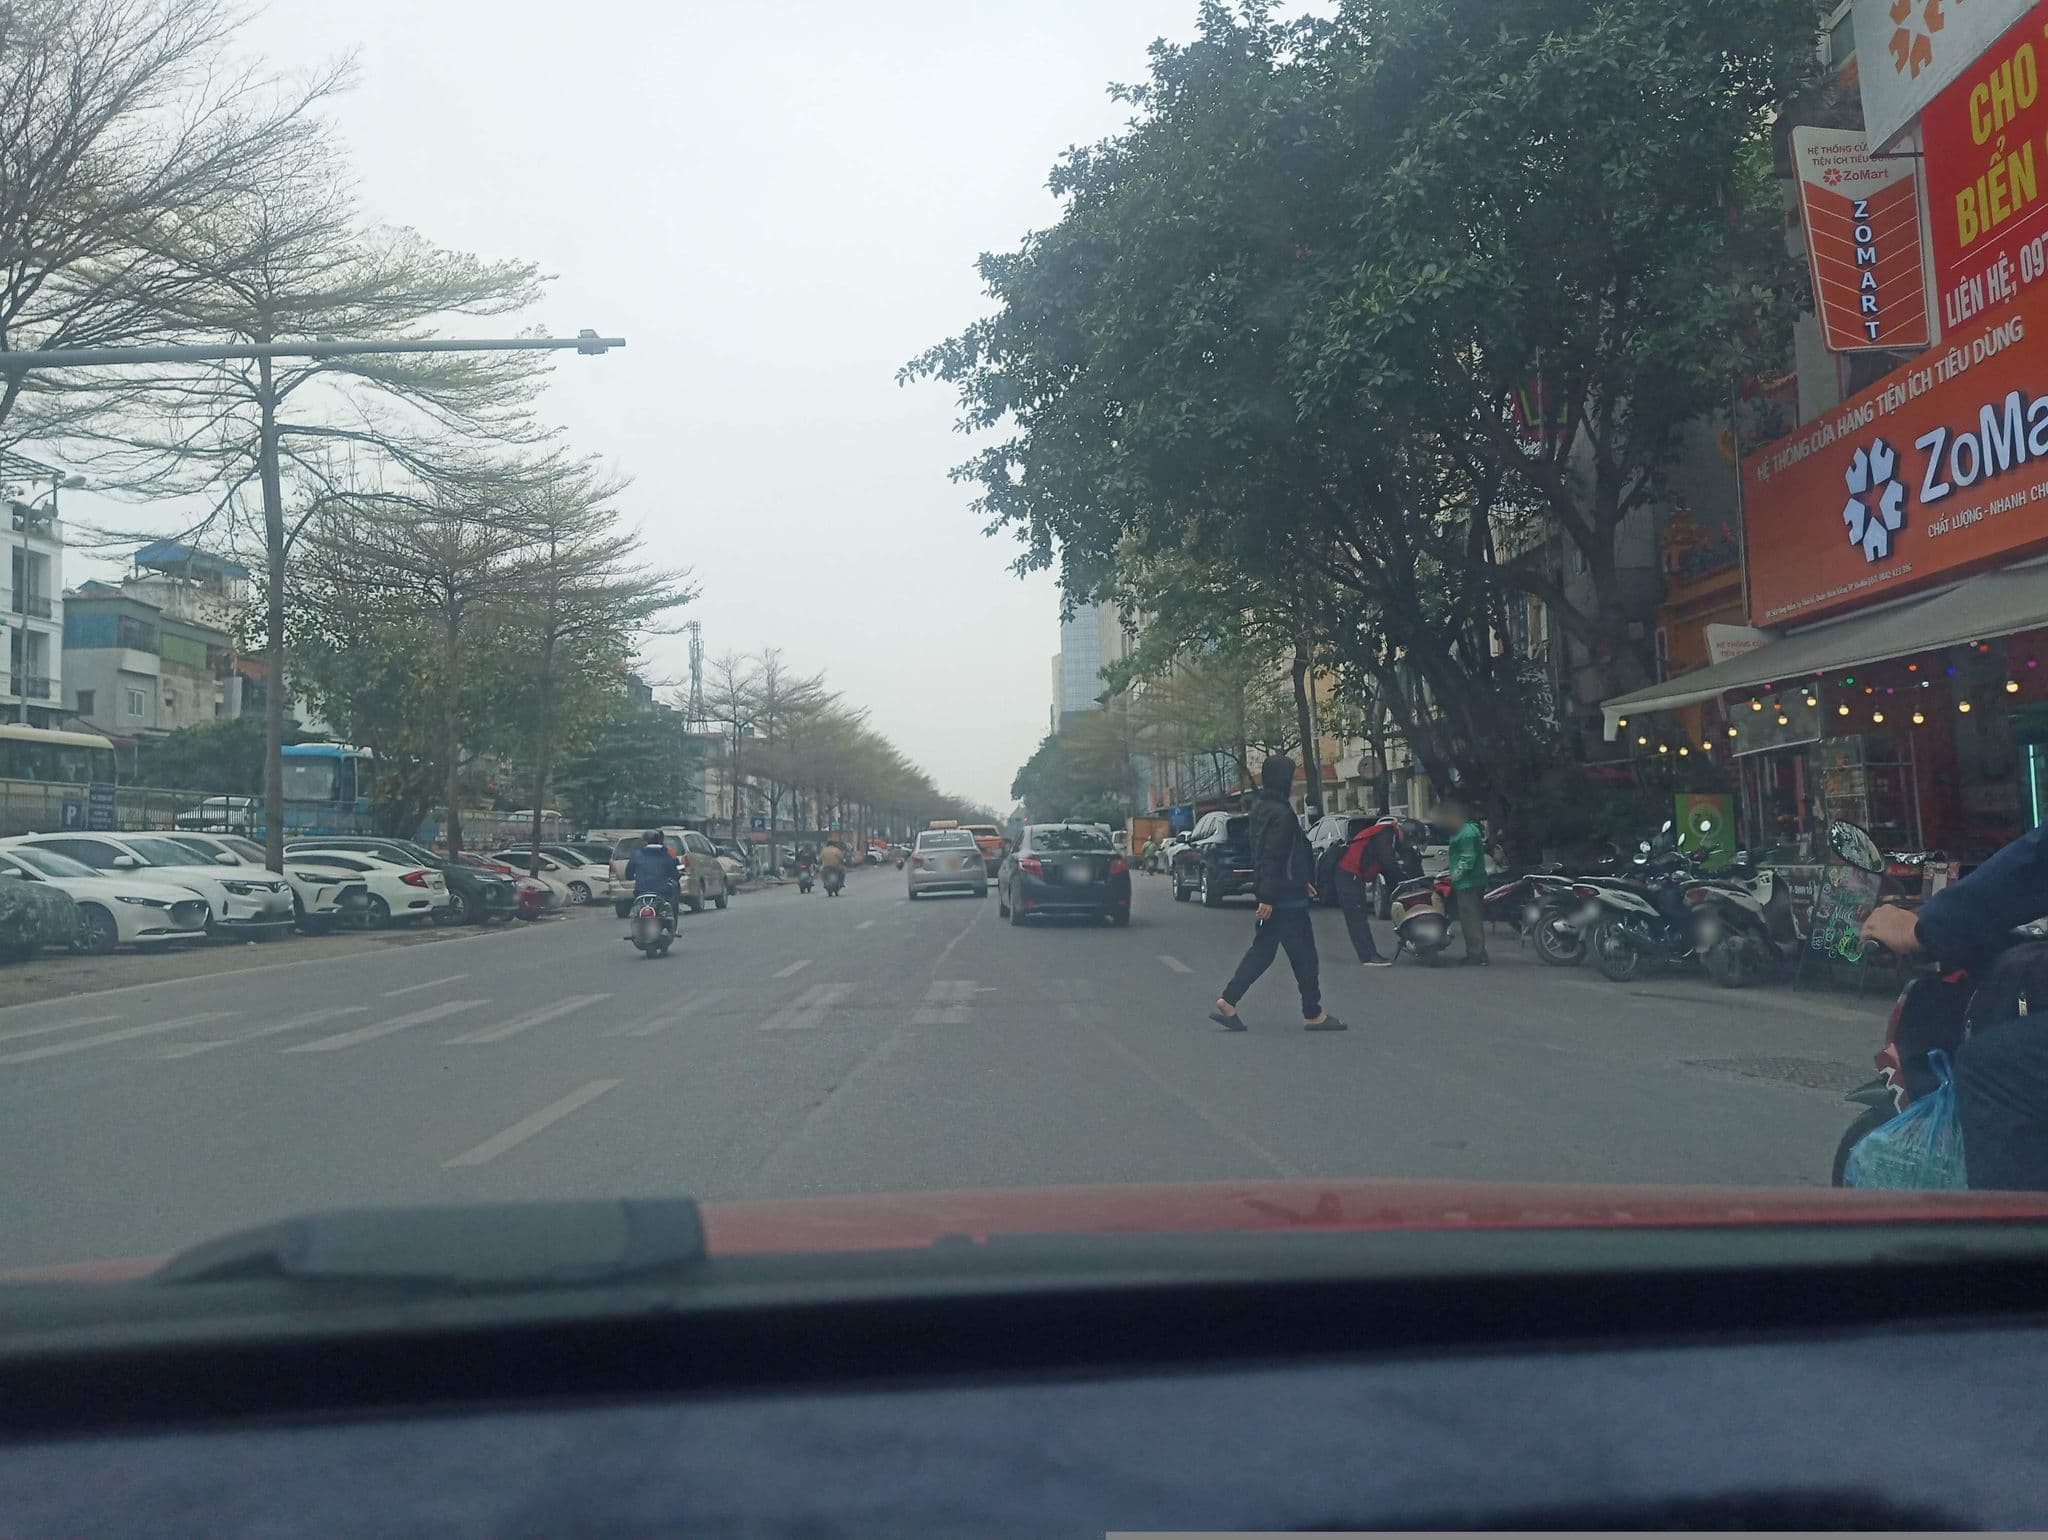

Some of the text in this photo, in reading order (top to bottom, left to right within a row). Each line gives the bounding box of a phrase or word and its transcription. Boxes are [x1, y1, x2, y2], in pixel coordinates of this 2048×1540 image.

[1969, 43, 2038, 146] CHO
[1843, 168, 1889, 181] ZoMart
[1854, 142, 1869, 153] CỬ
[1956, 135, 2038, 248] BIỂN
[1854, 200, 1880, 339] ZOMART
[1945, 273, 1984, 329] LIÊN
[1757, 314, 2024, 482] HỆ THỐNG CỬA HÀNG TIỆN ÍCH TIÊU DÙNG
[1928, 512, 1950, 538] CHẤT
[1951, 506, 1983, 529] LƯỢNG
[1989, 490, 2026, 516] NHANH
[2030, 480, 2048, 501] CH
